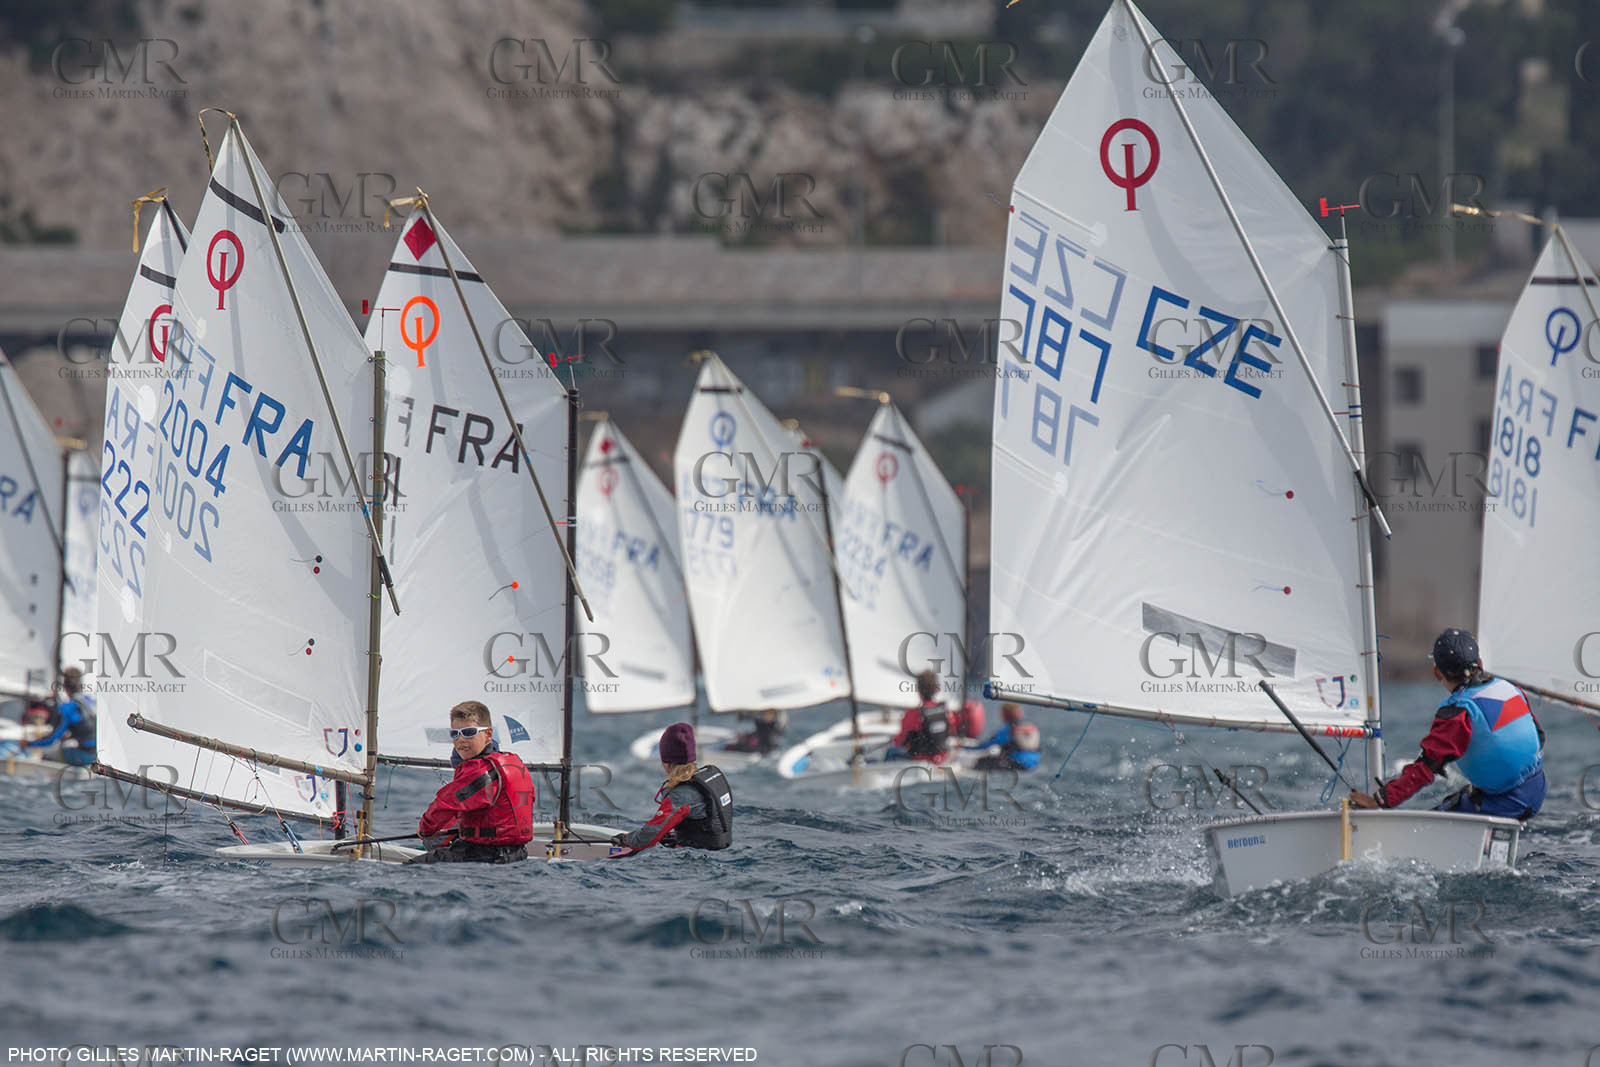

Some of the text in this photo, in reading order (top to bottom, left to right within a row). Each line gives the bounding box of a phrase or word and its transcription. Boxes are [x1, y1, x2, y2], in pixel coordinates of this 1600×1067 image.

[1136, 285, 1283, 400] CZE
[160, 379, 231, 498] 2004
[215, 371, 314, 479] FRA
[426, 404, 524, 474] FRA
